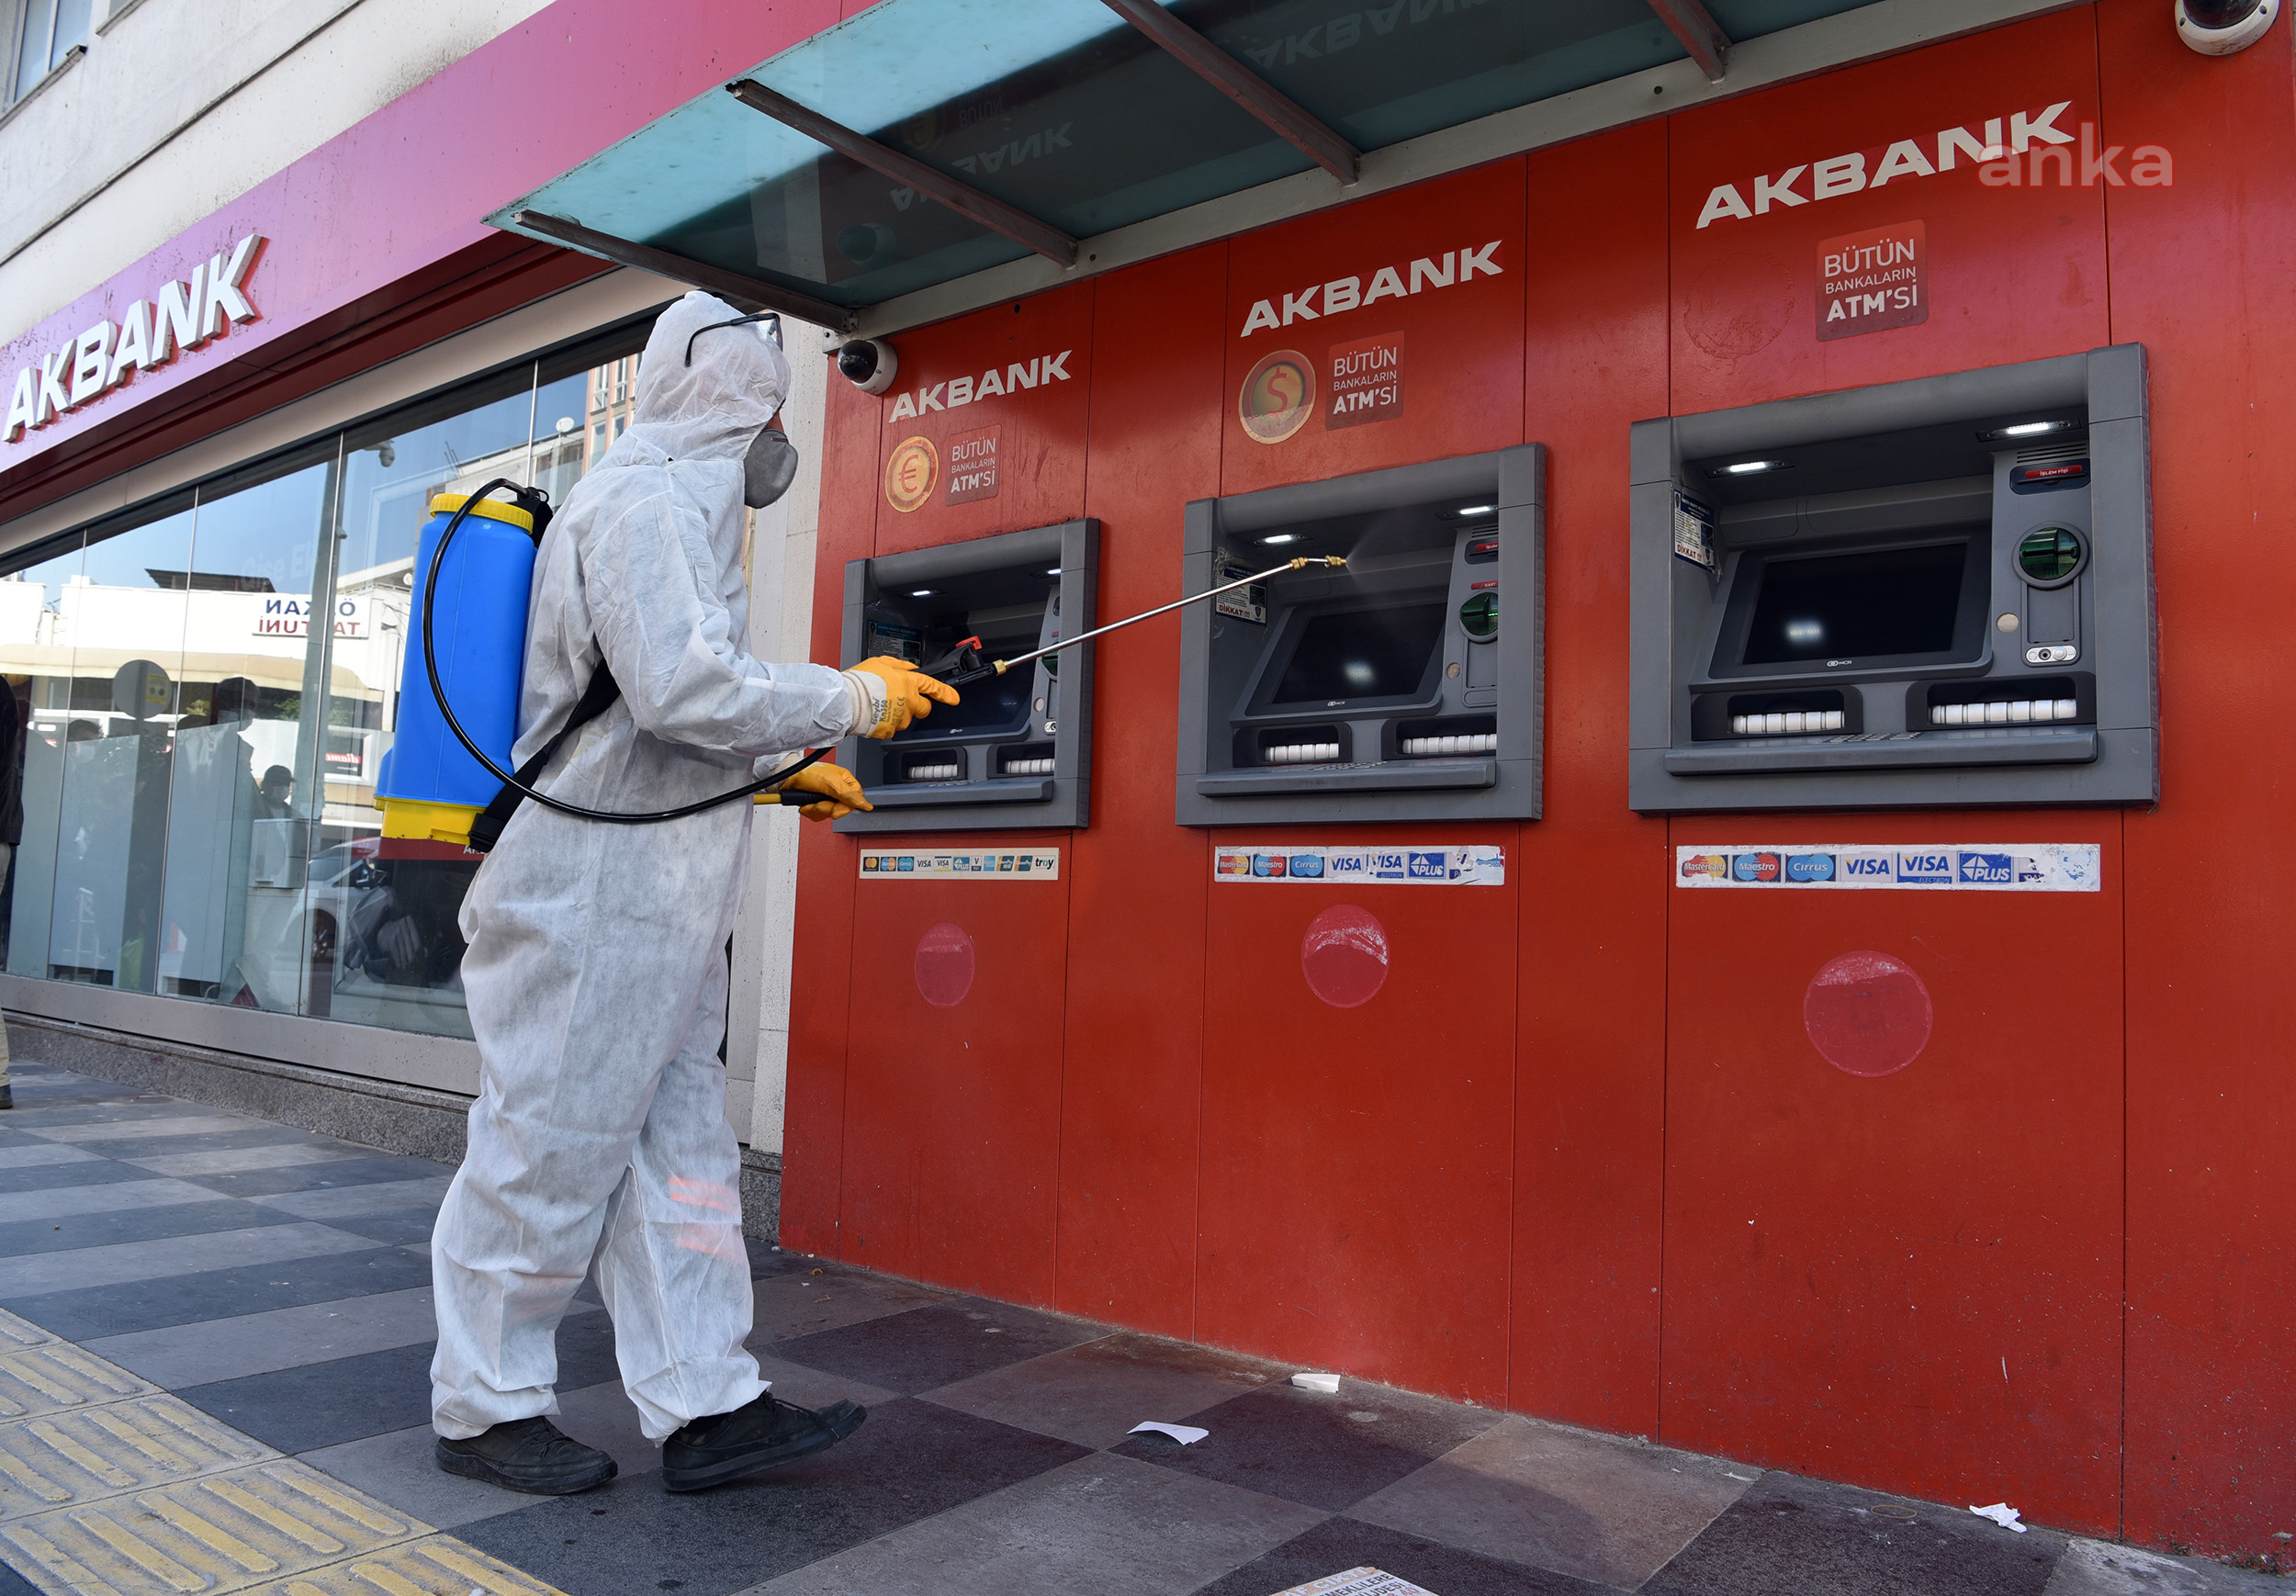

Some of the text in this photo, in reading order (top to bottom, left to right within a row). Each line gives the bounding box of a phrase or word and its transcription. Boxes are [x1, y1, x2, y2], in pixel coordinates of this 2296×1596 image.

[1695, 100, 2076, 230] AKBANK
[1824, 238, 1915, 277] BÜTÜN
[1241, 240, 1504, 337] AKBANK
[1825, 266, 1917, 295] BANKALARIN
[1827, 279, 1918, 322] ATM'Sİ
[2, 233, 266, 444] AKBANK
[1334, 346, 1397, 377] BÜTÜN
[889, 350, 1073, 423] AKBANK
[1334, 370, 1397, 391] BANKALARIN
[1333, 380, 1397, 415] ATM'Sİ
[951, 436, 996, 462] BÜTÜN
[951, 456, 996, 474] BANKALARIN
[951, 466, 996, 493] ATM'Sİ
[917, 860, 931, 868] VISA
[1035, 858, 1054, 870] troy
[1256, 860, 1284, 869] Maestro
[1294, 860, 1320, 869] Cirrus
[1331, 857, 1362, 871] VISA
[1419, 864, 1444, 876] PLUS
[1370, 854, 1403, 869] VISA
[1739, 861, 1775, 871] Maestro
[1793, 861, 1828, 872] Cirrus
[1844, 859, 1891, 875] VISA
[1975, 867, 2011, 881] PLUS
[1903, 855, 1950, 872] VISA
